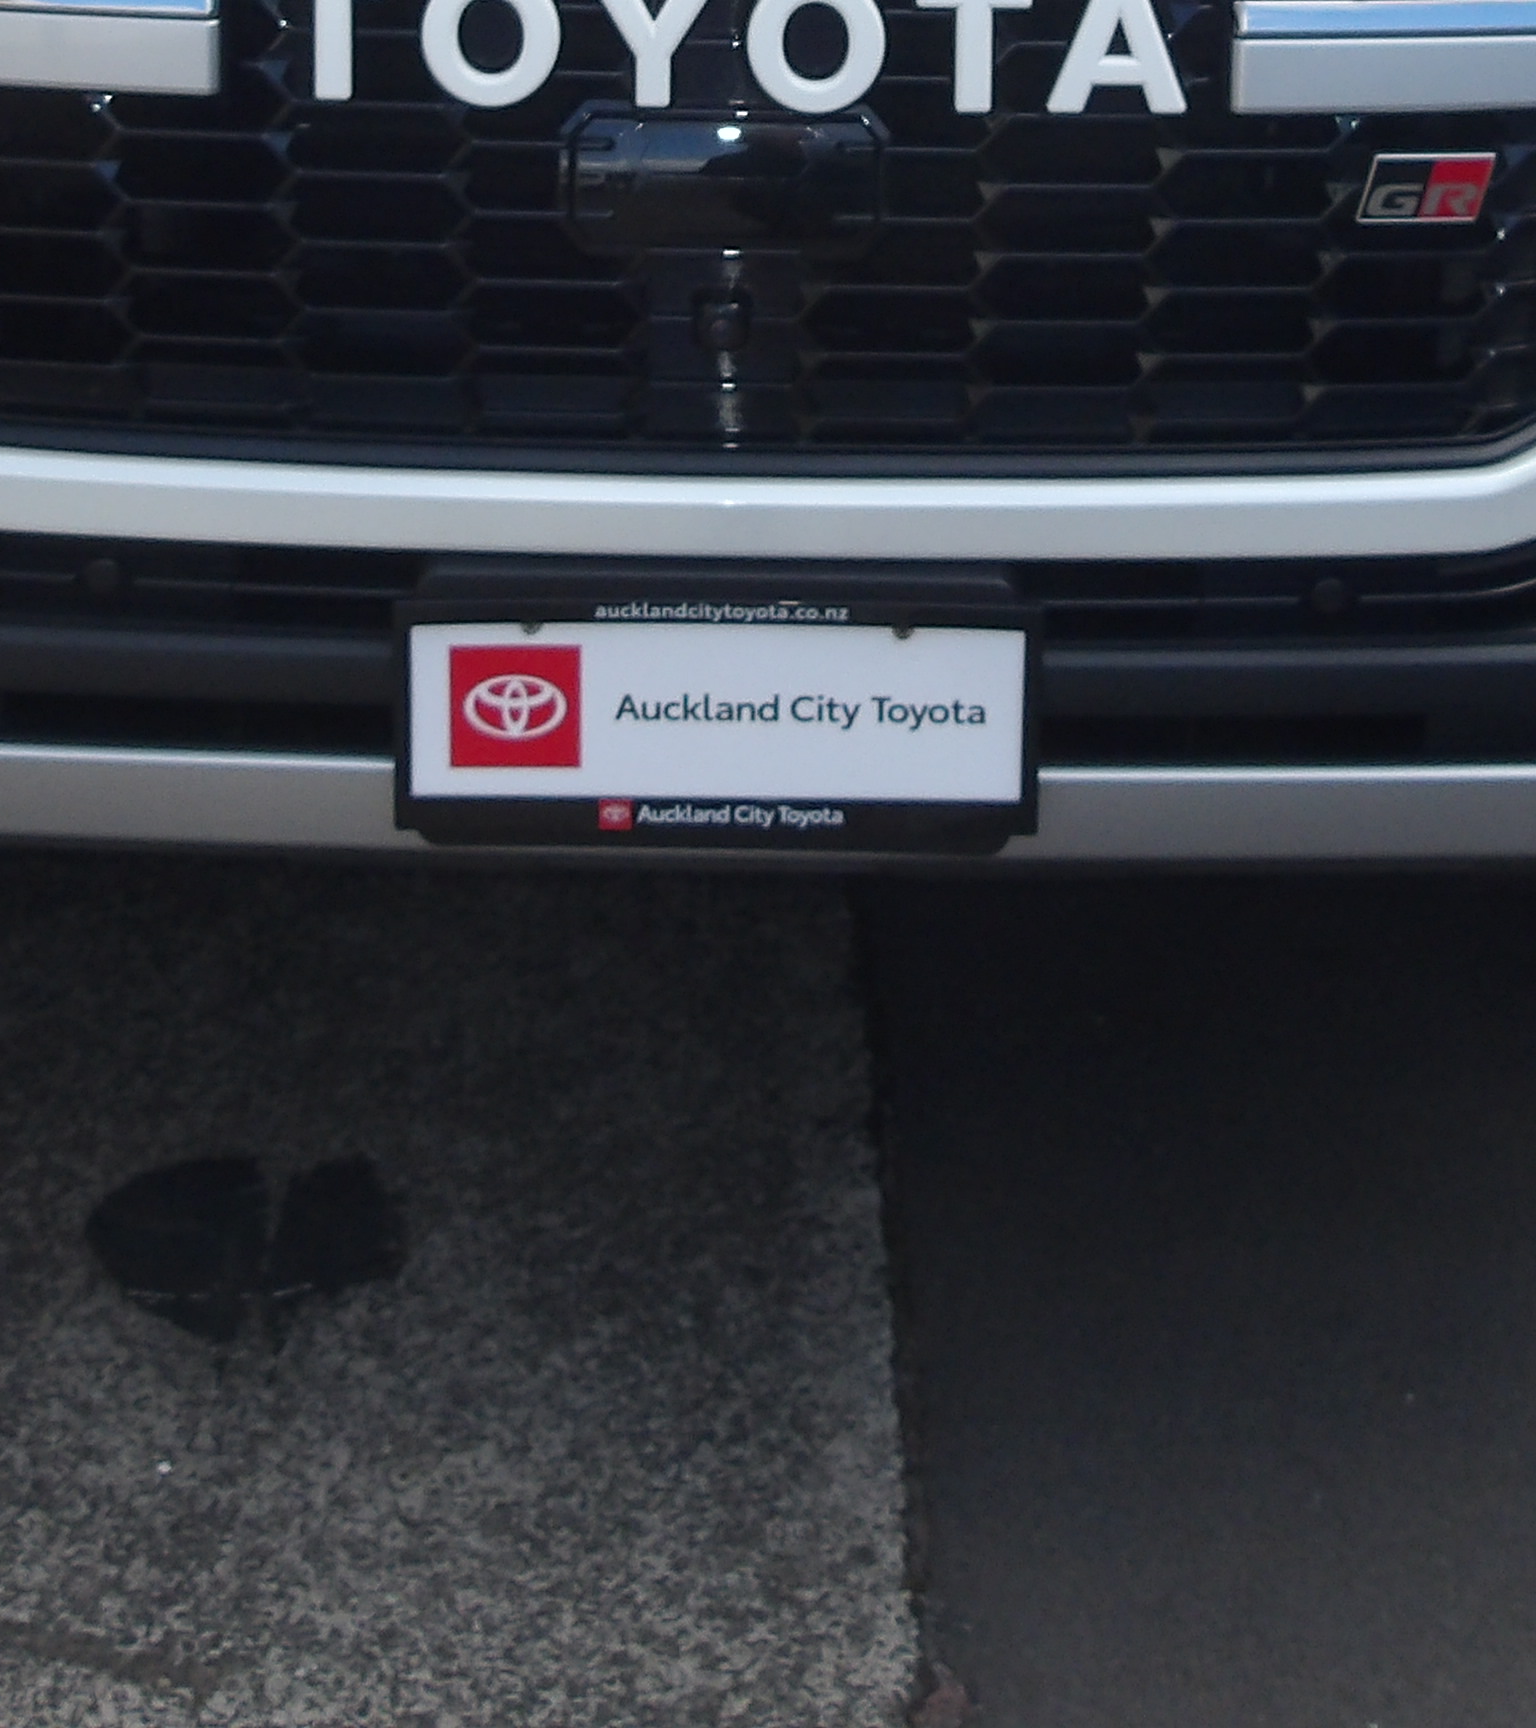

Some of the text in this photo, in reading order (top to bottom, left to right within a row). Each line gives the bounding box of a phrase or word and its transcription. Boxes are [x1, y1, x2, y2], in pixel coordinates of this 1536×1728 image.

[1366, 183, 1478, 216] GR
[594, 602, 849, 622] aucklandcitytoyota.co.nz
[615, 693, 986, 731] Auckland City Toyota
[637, 804, 845, 828] Auckland City Toyota
